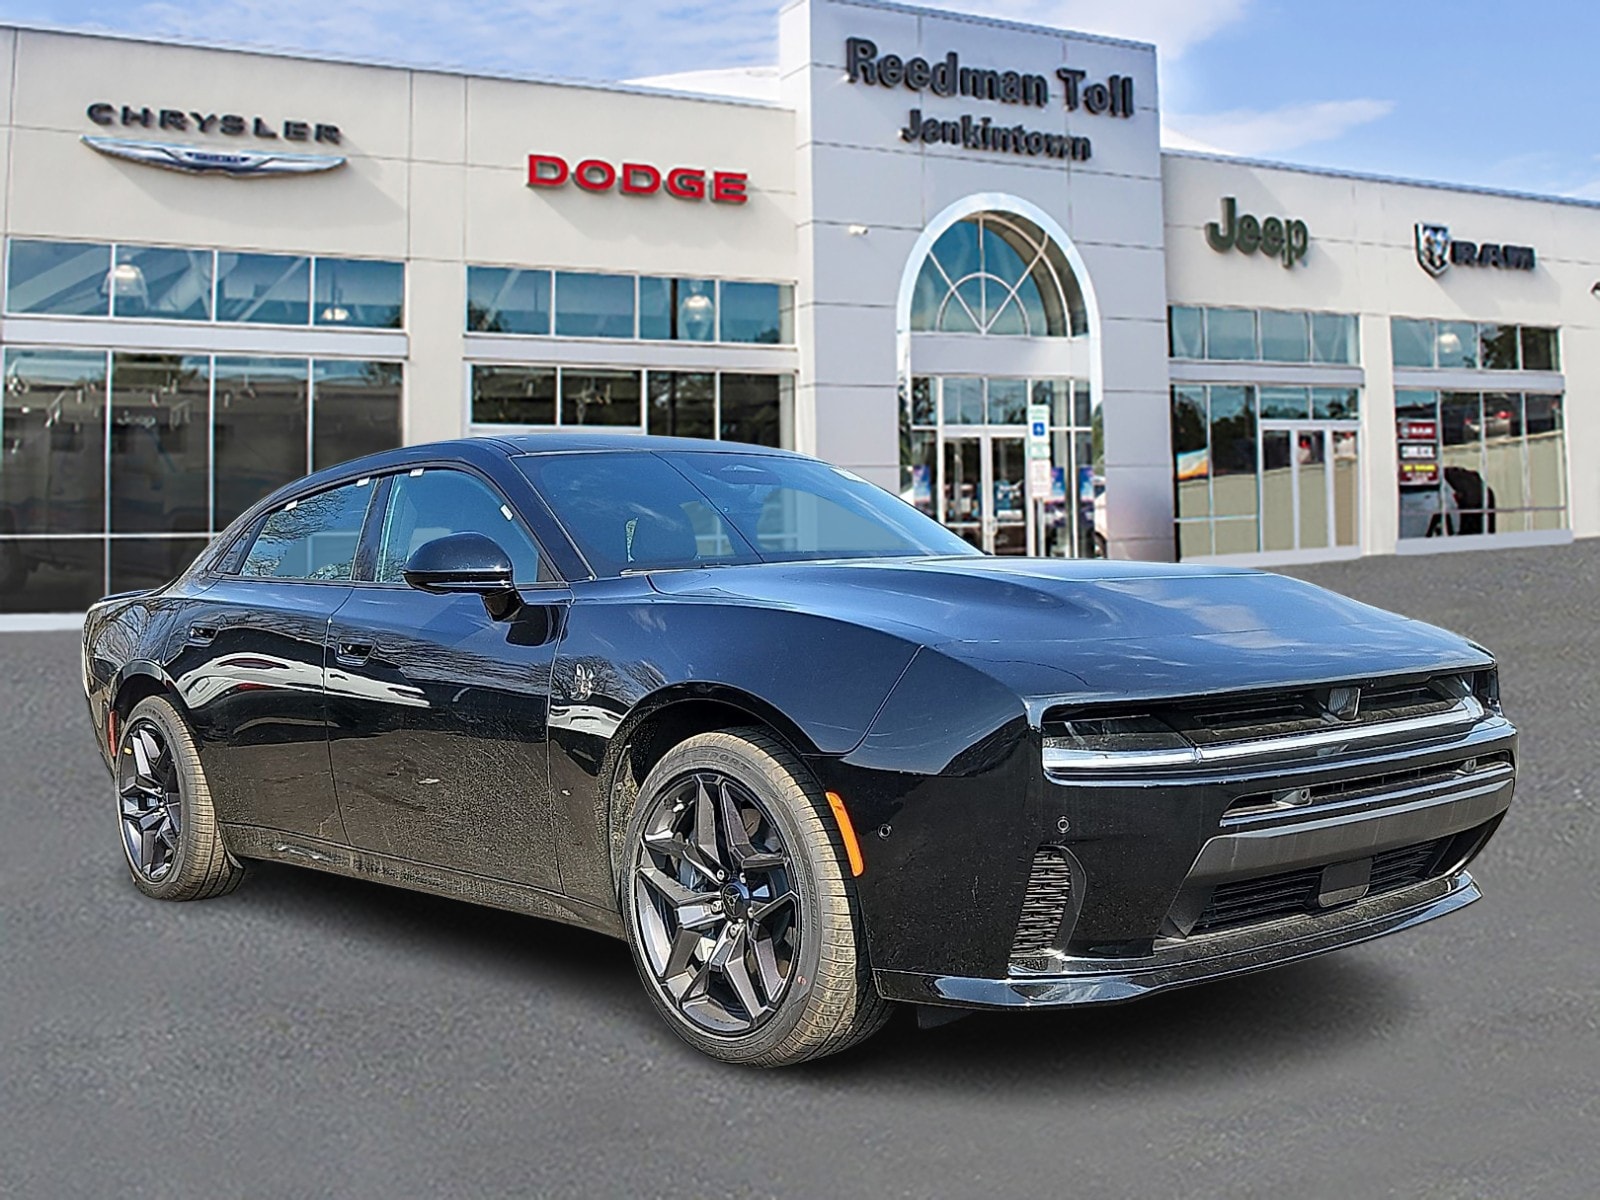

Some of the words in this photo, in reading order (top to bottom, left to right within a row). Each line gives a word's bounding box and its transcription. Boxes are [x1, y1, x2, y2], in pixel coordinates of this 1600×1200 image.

[845, 37, 1049, 107] Reedman
[1056, 67, 1134, 118] Toll
[86, 102, 341, 145] CHRYSLER
[901, 108, 1092, 161] Jenkintown
[526, 153, 749, 204] DODGE
[1204, 196, 1309, 269] Jeep
[1451, 240, 1536, 271] RAM
